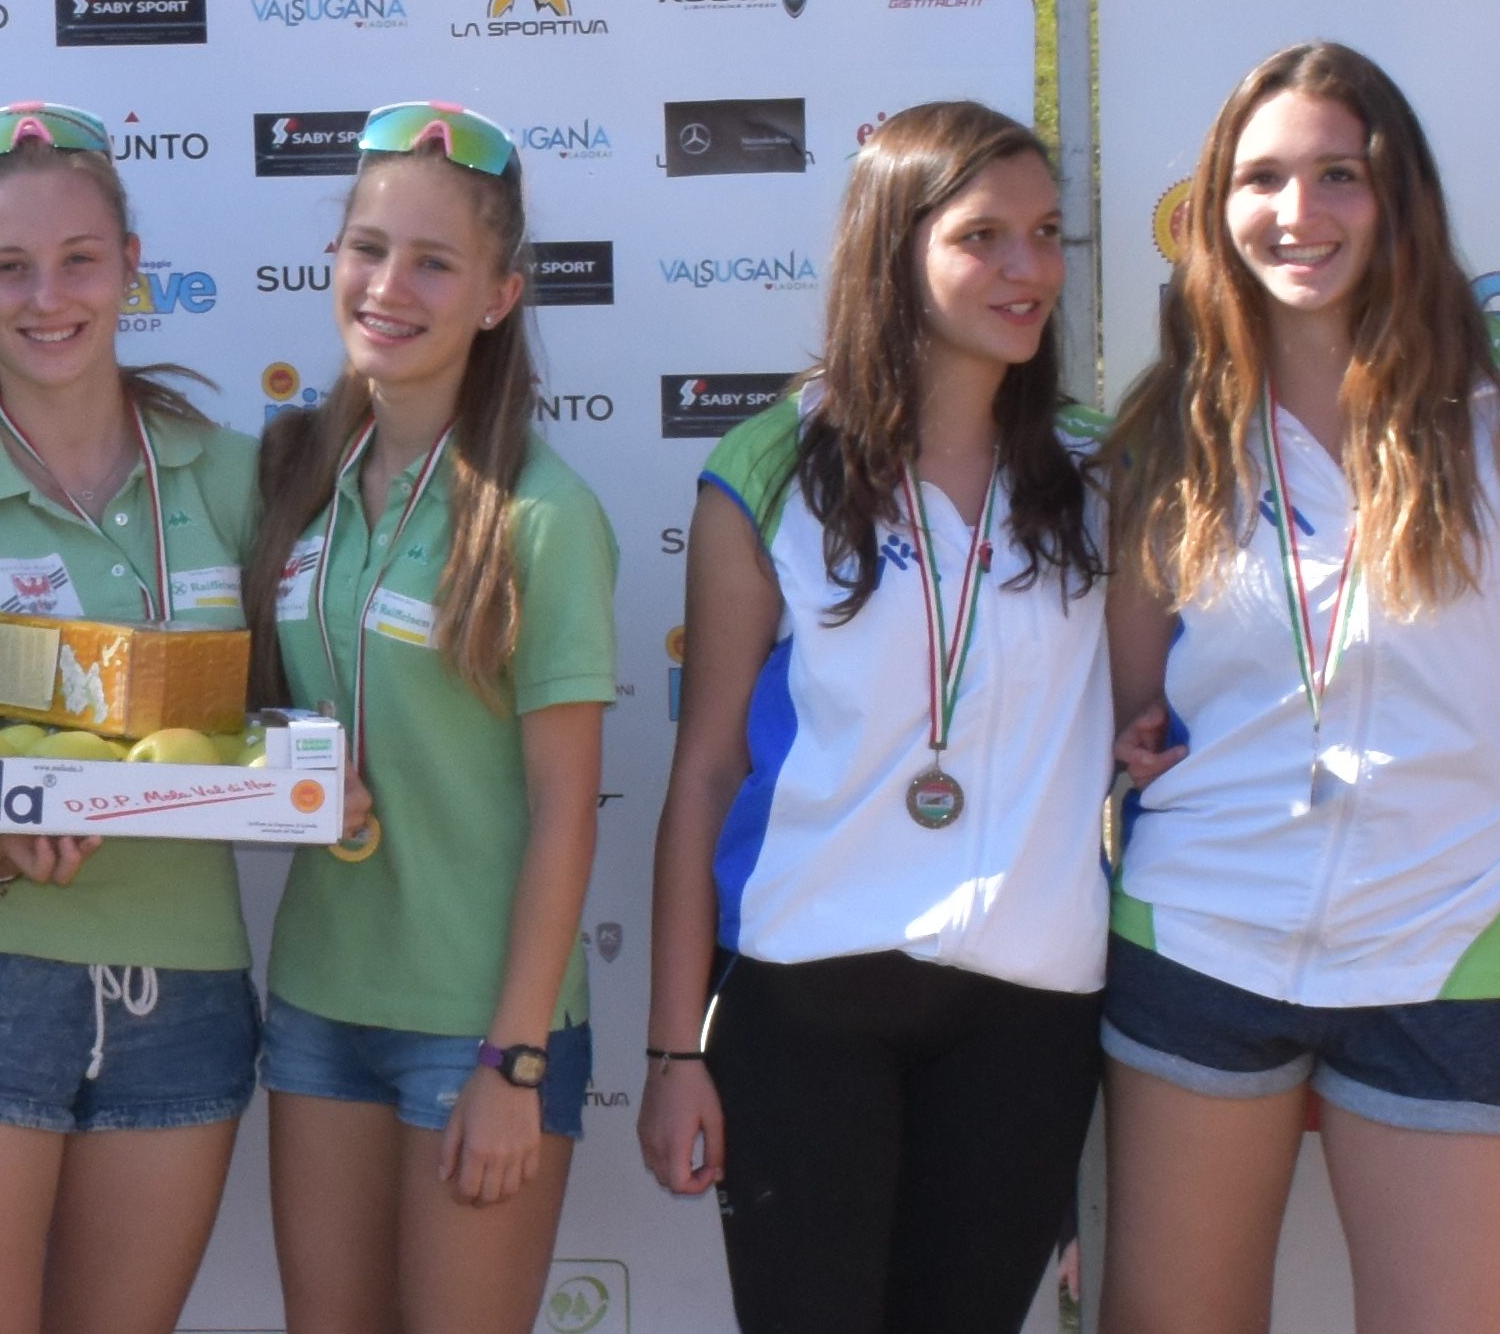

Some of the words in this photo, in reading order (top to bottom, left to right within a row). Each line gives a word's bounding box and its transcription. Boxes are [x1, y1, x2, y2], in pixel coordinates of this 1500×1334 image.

[92, 2, 132, 15] SABY
[136, 0, 189, 14] SPORT
[451, 22, 480, 38] LA
[487, 19, 609, 37] SPORTIVA
[112, 134, 209, 160] UNTO
[292, 132, 334, 145] SABY
[541, 260, 595, 275] SPORT
[660, 251, 818, 288] VALSUGANA
[257, 265, 332, 293] SUU
[120, 270, 217, 315] ave
[537, 394, 614, 422] NTO
[701, 393, 743, 406] SABY
